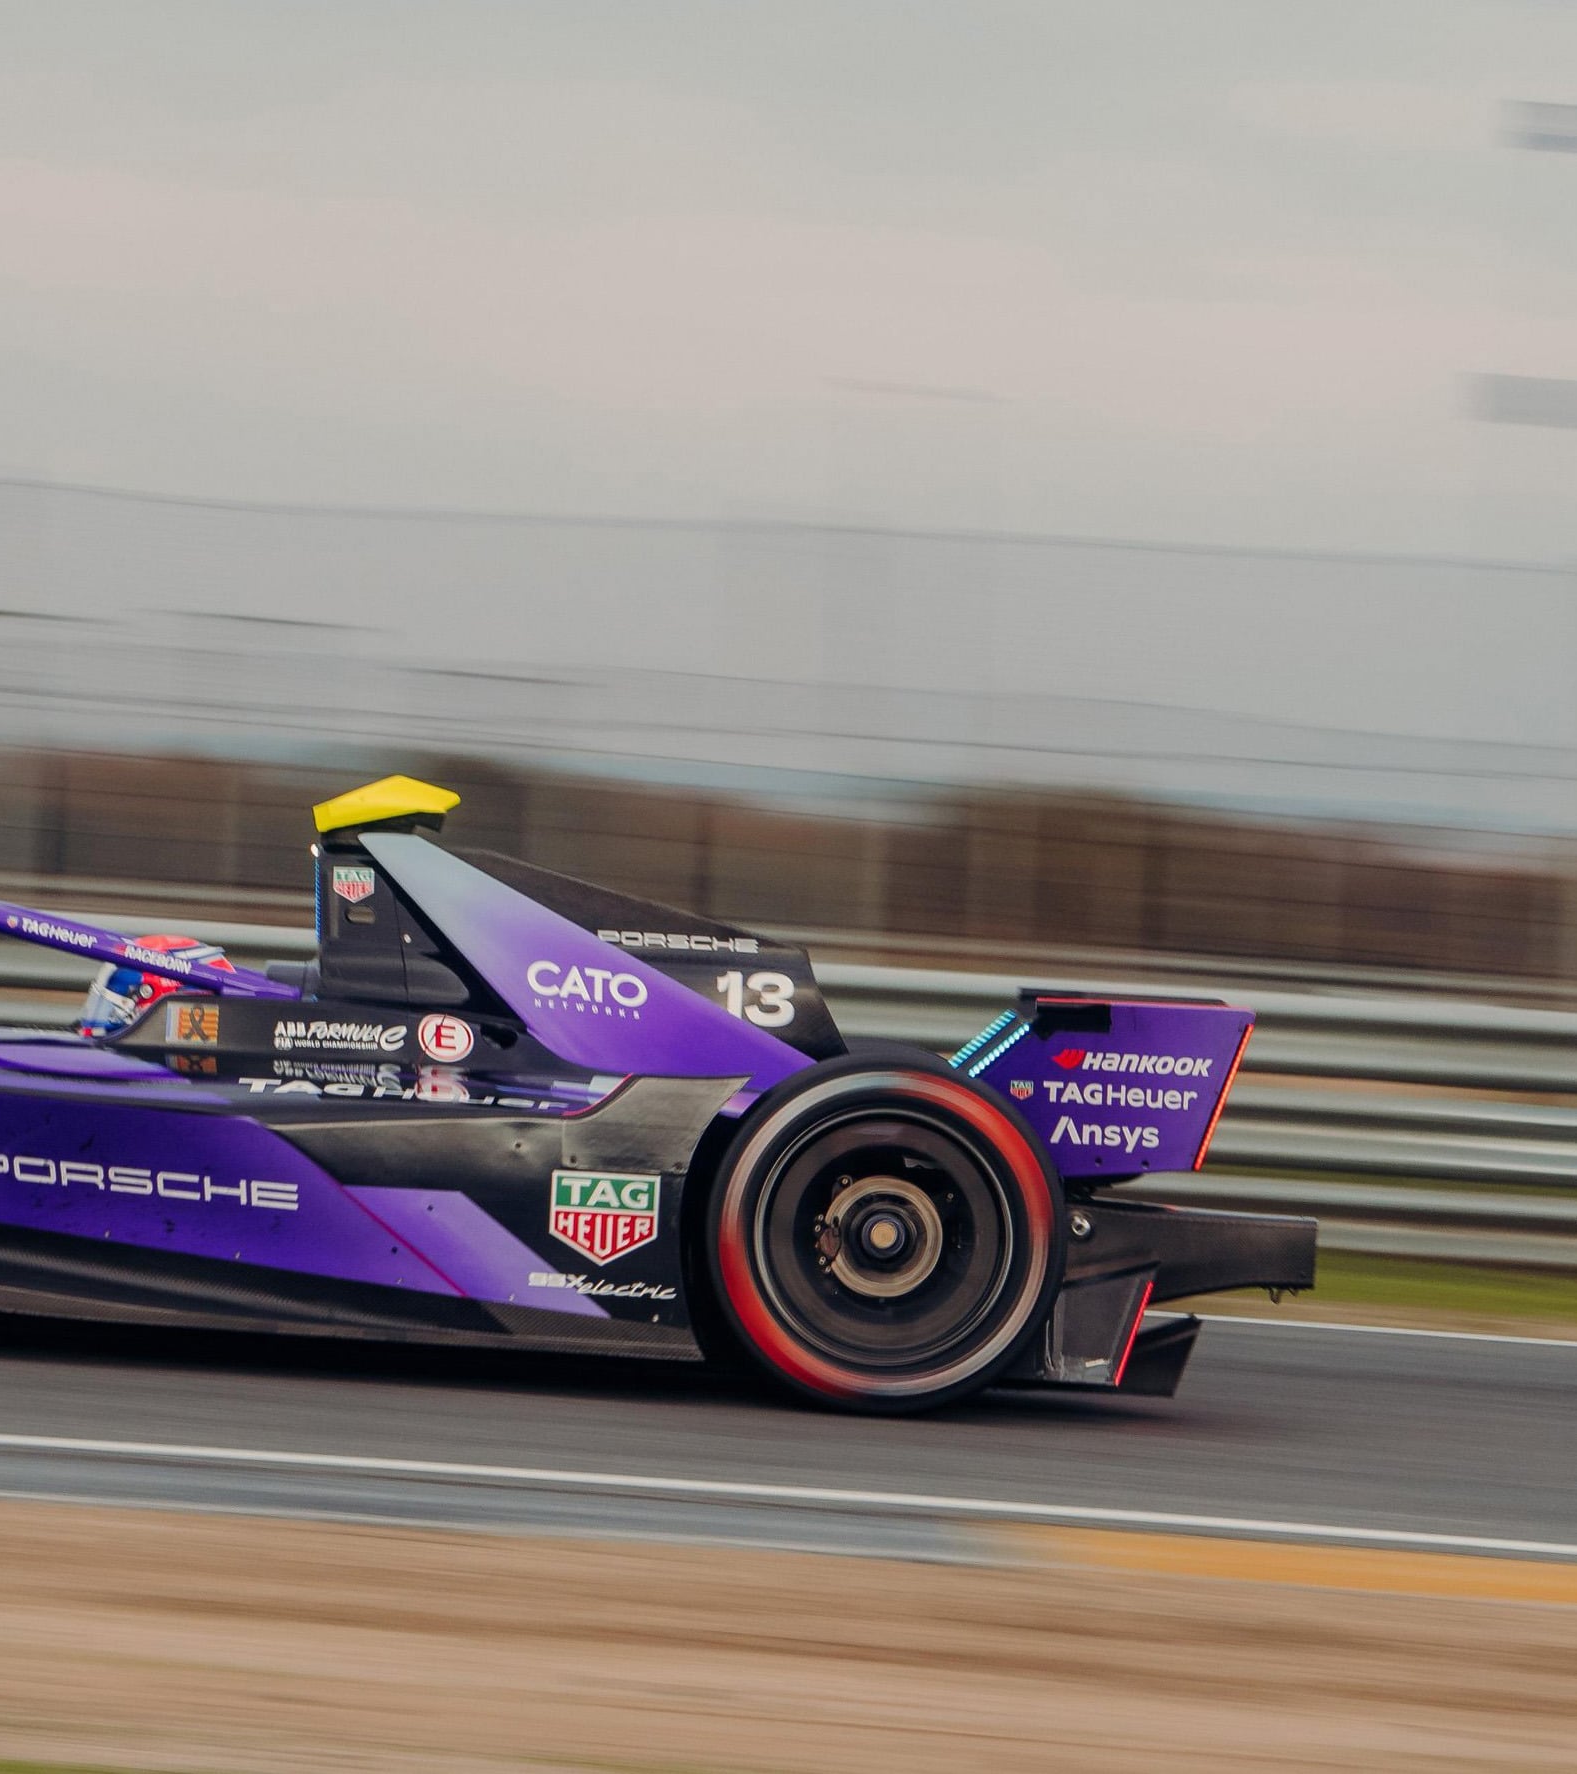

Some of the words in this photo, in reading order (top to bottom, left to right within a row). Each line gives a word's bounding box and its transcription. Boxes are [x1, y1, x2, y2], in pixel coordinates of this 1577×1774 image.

[597, 929, 759, 954] PORSCHE
[526, 960, 648, 1007] CATO
[534, 998, 641, 1020] NETWORKS
[716, 970, 795, 1027] 13
[294, 1040, 321, 1049] WORLD
[307, 1021, 382, 1043] FORMULA
[435, 1025, 456, 1050] E
[1050, 1115, 1159, 1153] Ansys
[561, 1178, 649, 1209] TAG
[557, 1212, 652, 1256] HEUER
